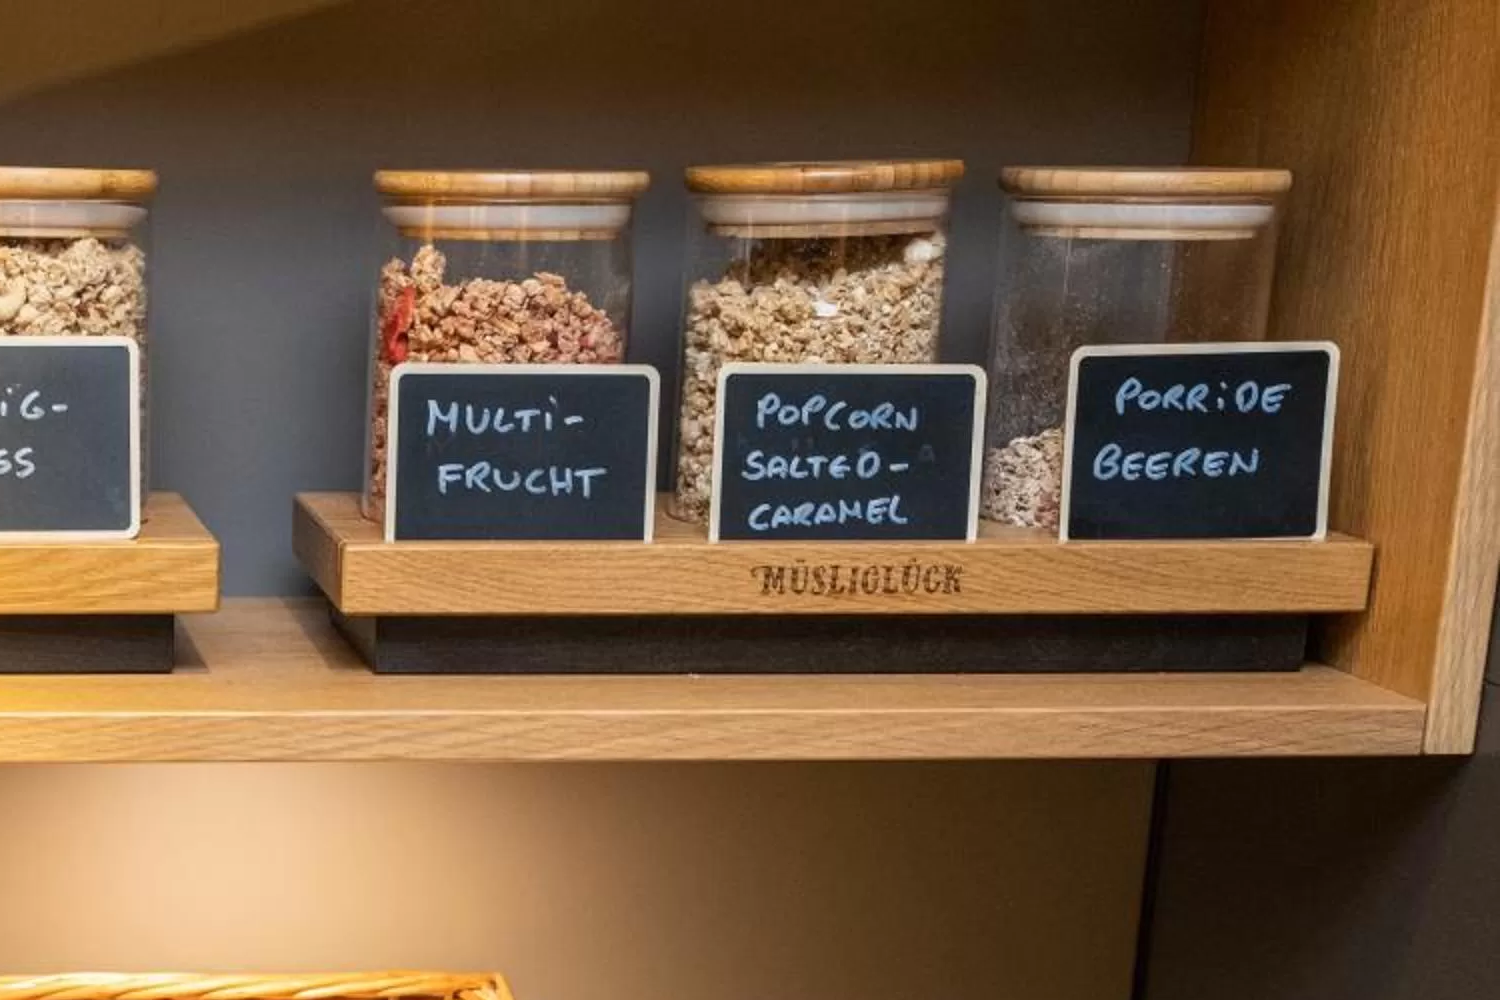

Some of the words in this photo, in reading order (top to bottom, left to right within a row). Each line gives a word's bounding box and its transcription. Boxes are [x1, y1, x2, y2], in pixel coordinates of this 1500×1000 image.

[756, 392, 918, 432] POPCORN
[437, 460, 608, 499] FRUCHT
[1092, 443, 1259, 481] BEEREN
[748, 495, 908, 531] CARAMEL
[750, 557, 966, 597] MÜSLIGLÜCK
